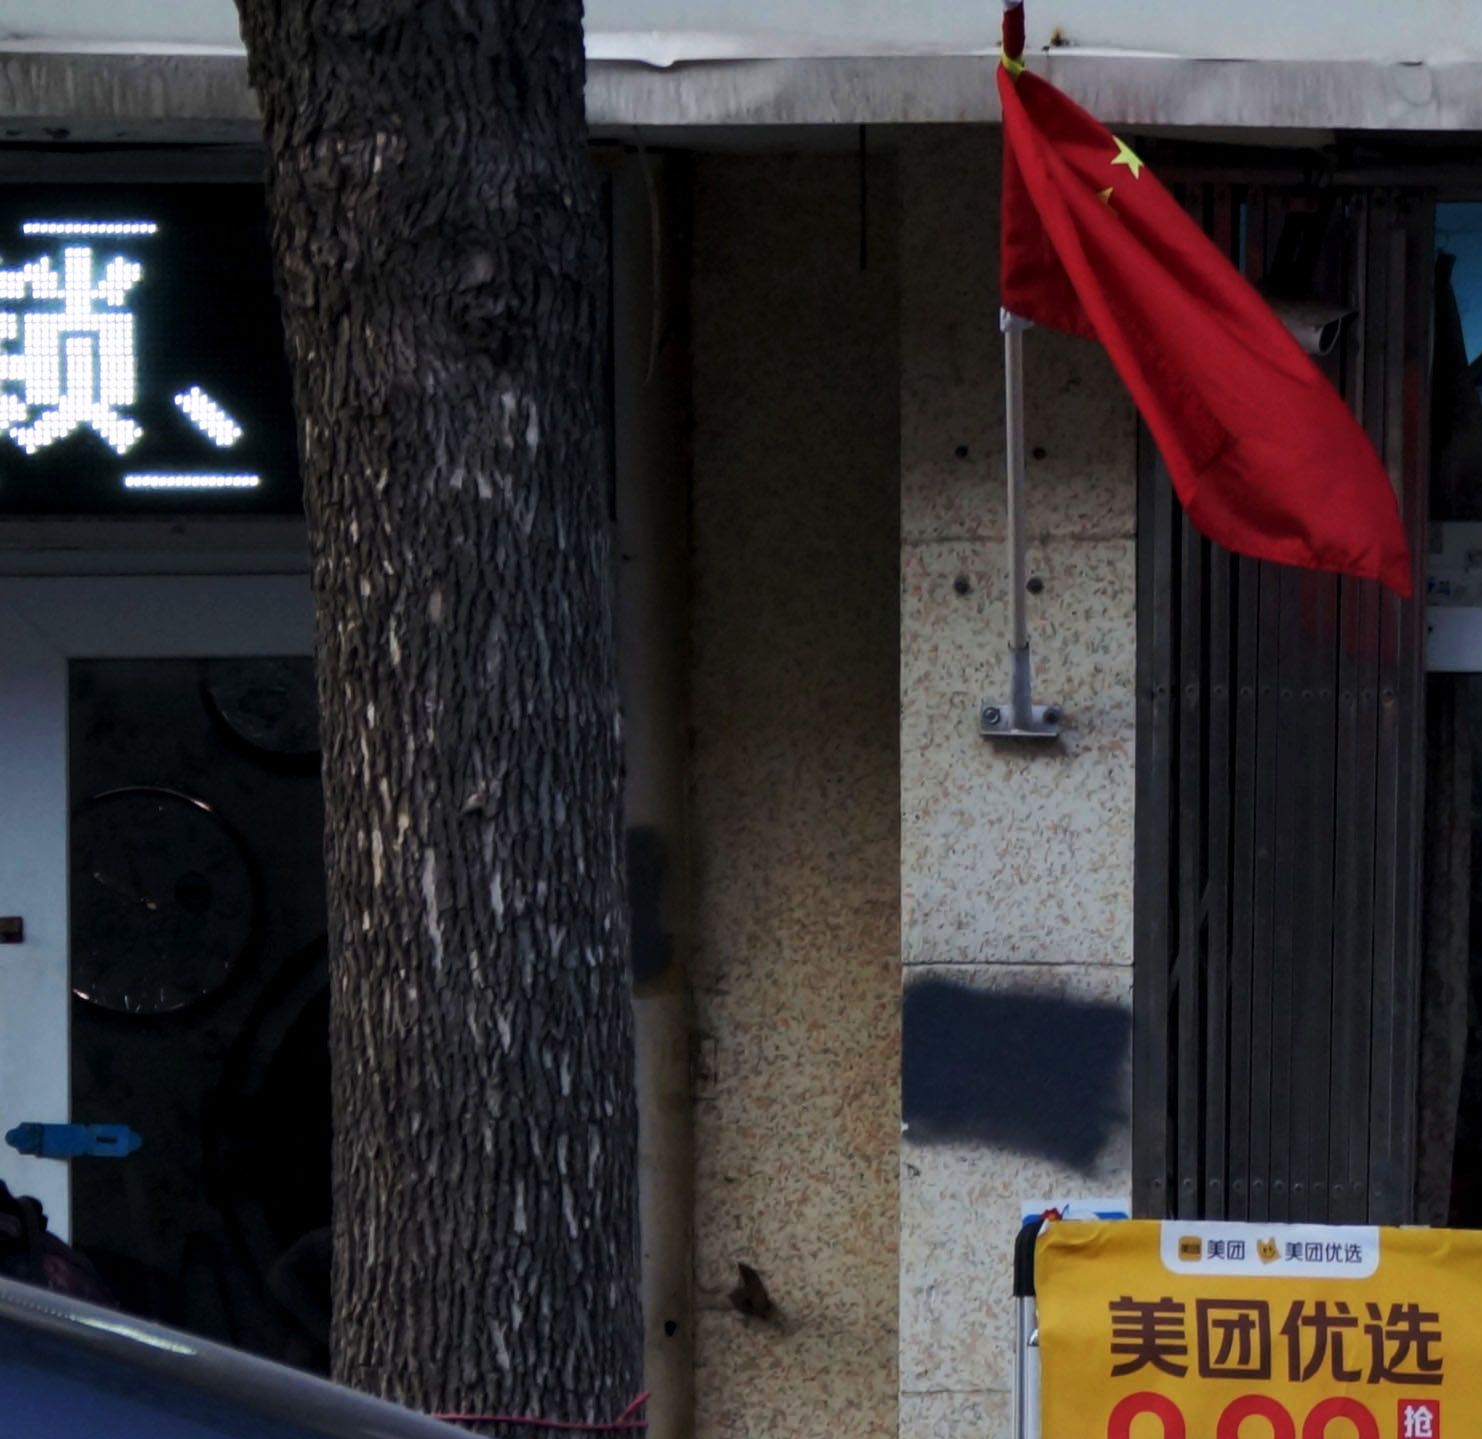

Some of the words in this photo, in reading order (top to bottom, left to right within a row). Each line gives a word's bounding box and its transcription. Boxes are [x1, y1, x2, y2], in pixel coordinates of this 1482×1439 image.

[1207, 1240, 1246, 1261] 美团
[1284, 1242, 1363, 1264] 美团优选
[1108, 1295, 1445, 1386] 美团优选
